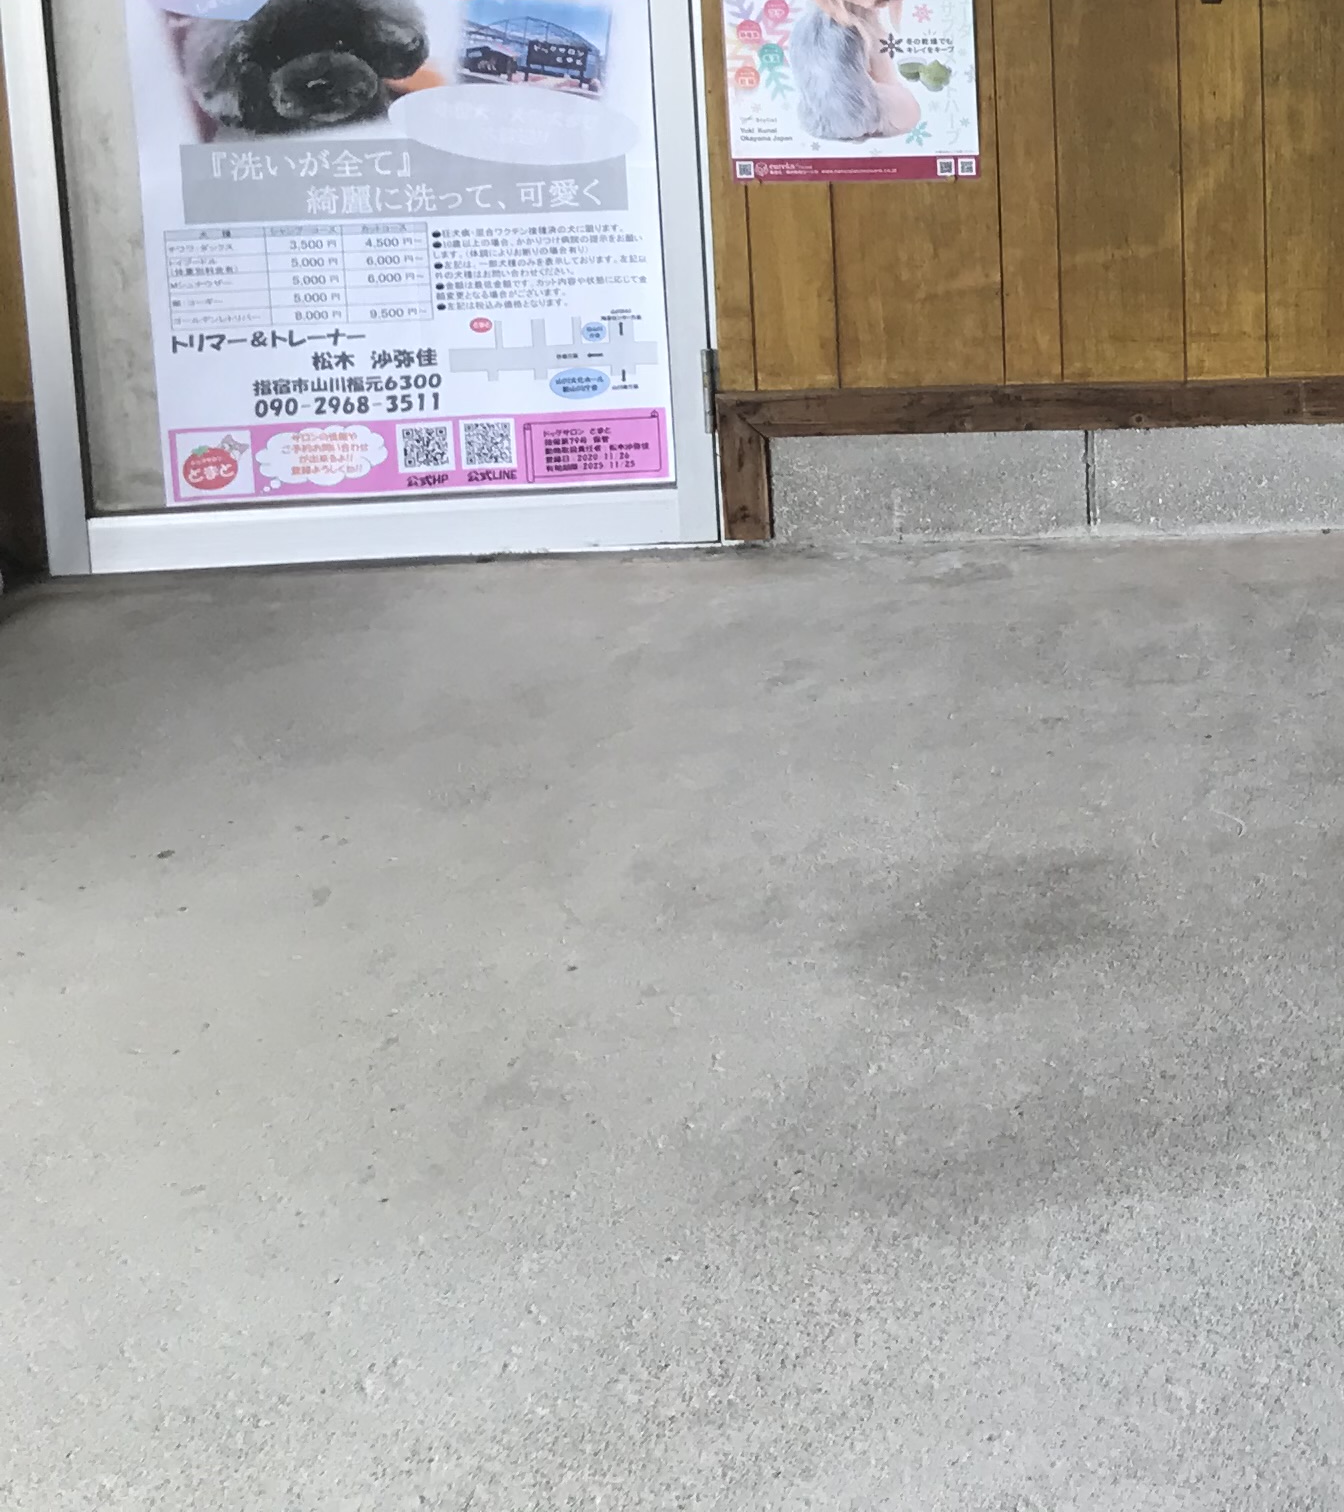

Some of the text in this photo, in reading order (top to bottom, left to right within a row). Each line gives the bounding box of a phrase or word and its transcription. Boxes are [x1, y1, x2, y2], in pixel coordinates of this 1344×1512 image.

[305, 178, 604, 216] 綺麗に洗って、可愛く
[311, 347, 439, 372] 松木 沙弥佳
[252, 371, 443, 397] 指宿市山川福元6300
[254, 393, 442, 419] 090-2968-3511
